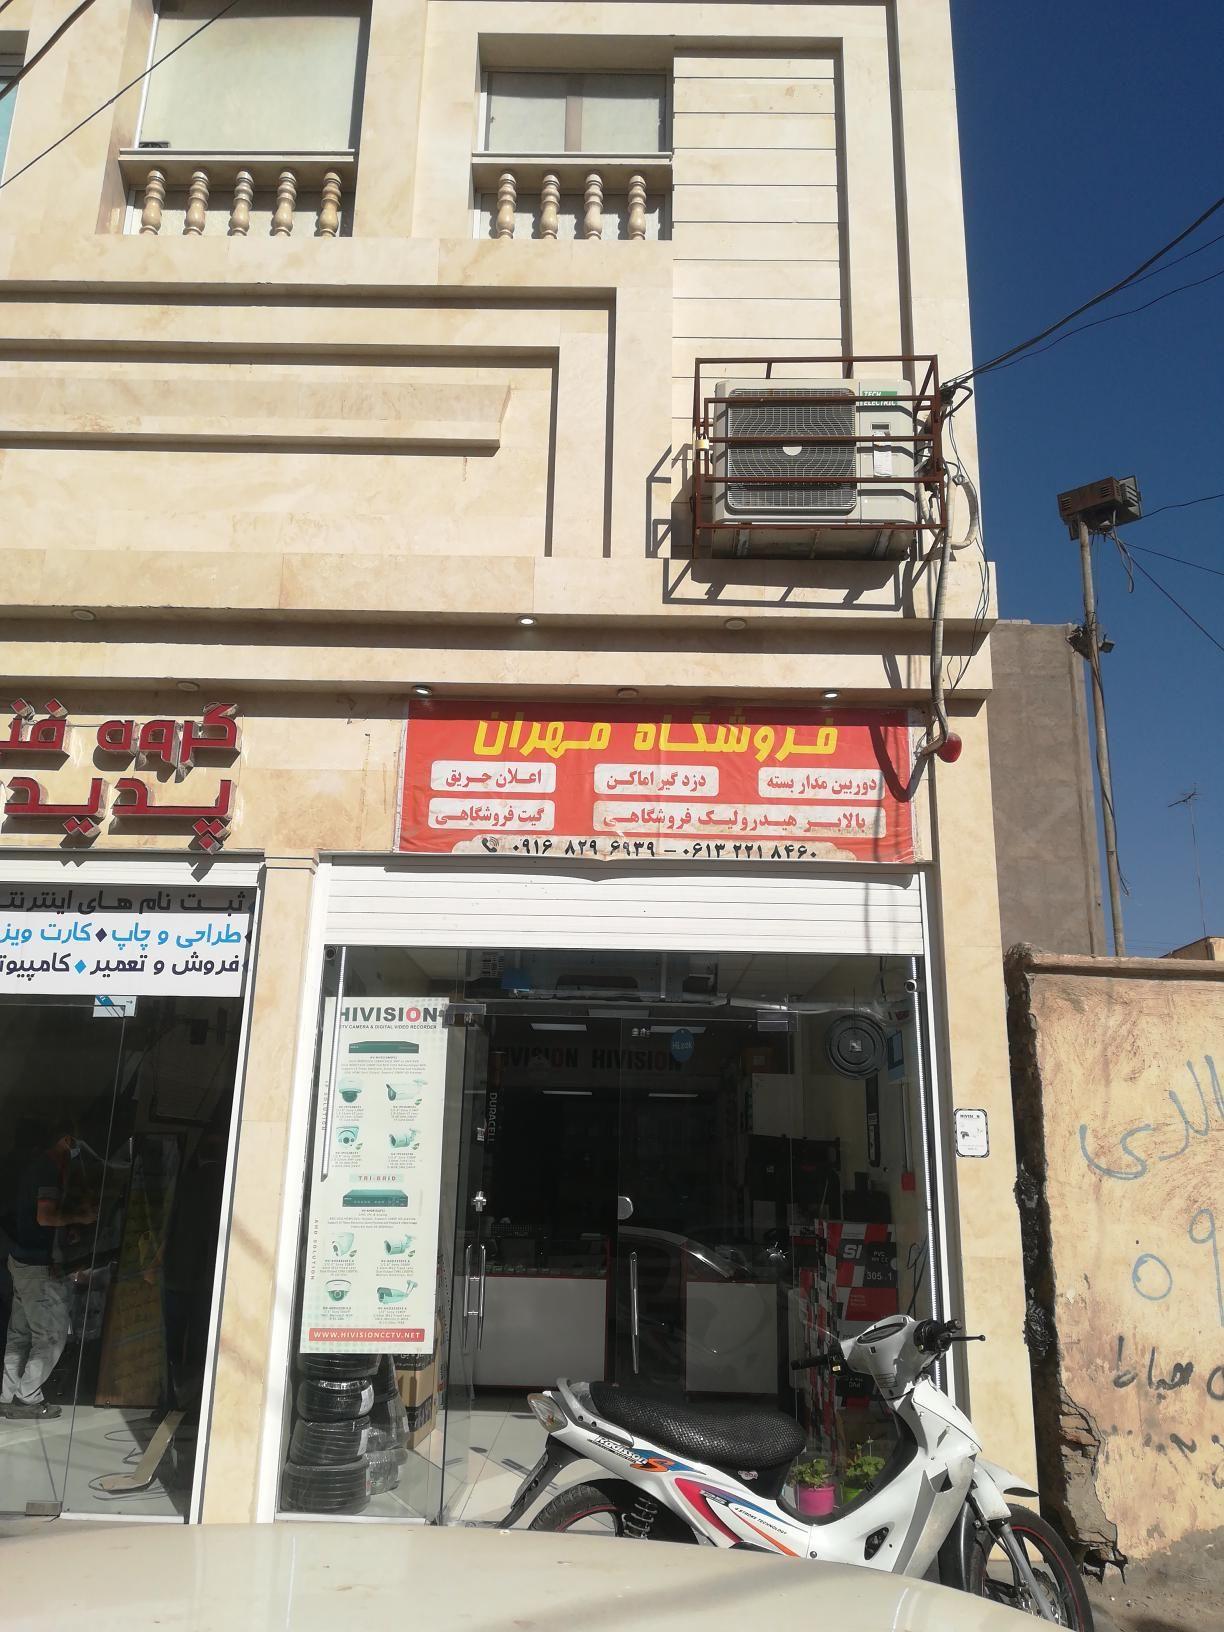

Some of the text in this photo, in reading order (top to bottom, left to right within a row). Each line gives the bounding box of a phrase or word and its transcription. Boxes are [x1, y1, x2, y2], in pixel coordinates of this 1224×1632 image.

[0, 698, 238, 764] گروه فن
[473, 705, 839, 762] فروشگاه مهران
[445, 768, 542, 788] اعلان حریق
[606, 770, 654, 790] اماکن
[766, 773, 877, 796] دوربین مدار بسته
[0, 776, 234, 855] پدید
[435, 806, 545, 827] گیت فروشگاهی
[603, 807, 866, 834] بالابر هیدرولیک فروشگاهی
[0, 890, 246, 917] ثبت نام های اینترنت
[0, 921, 242, 951] طراحی و چاپ کارت ویز
[0, 951, 240, 981] فروش و تعمیر کامپیوت
